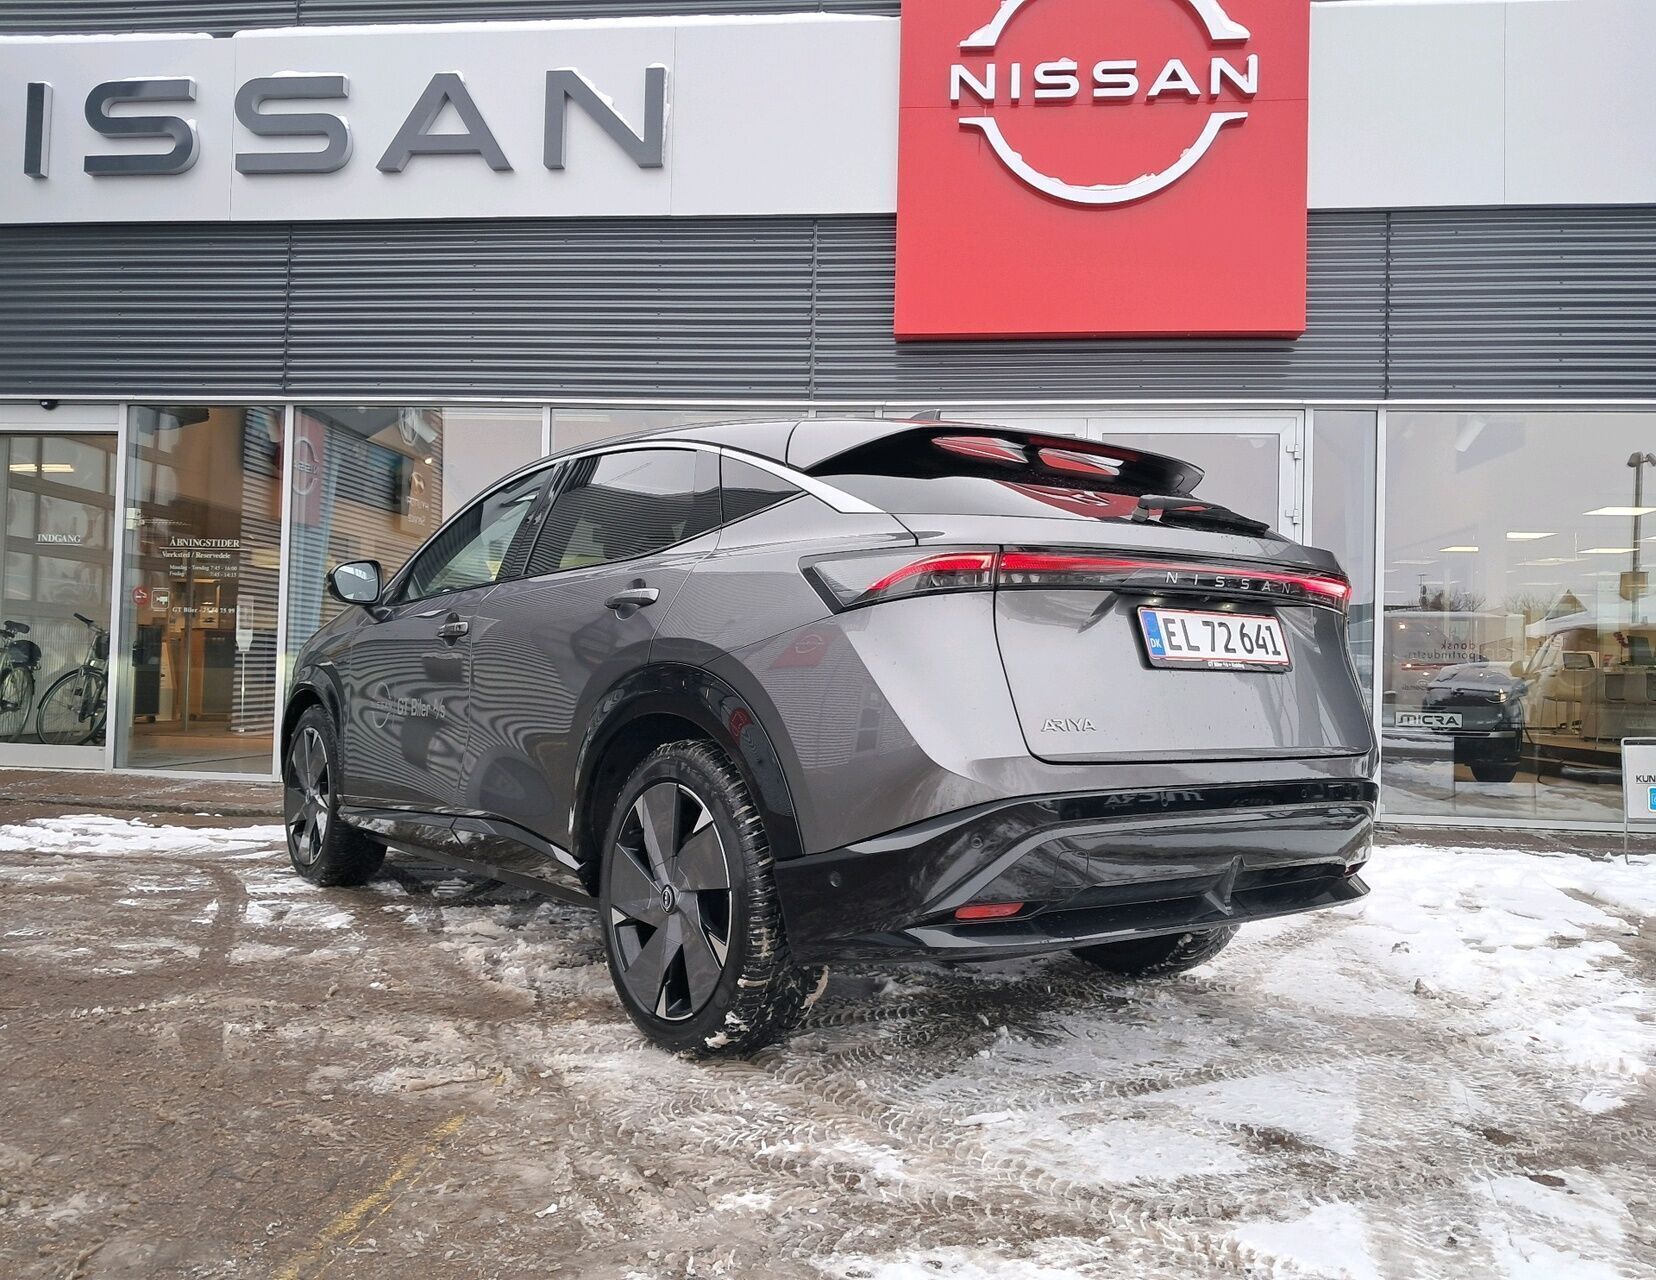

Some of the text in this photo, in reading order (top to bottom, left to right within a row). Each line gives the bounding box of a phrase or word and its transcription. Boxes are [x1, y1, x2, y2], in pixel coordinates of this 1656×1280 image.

[950, 54, 1258, 104] NISSAN
[36, 533, 81, 543] INDGANG
[169, 536, 240, 547] ÅBNINGSTIDER
[1165, 572, 1291, 594] NISSAN
[1162, 618, 1200, 651] EL
[1150, 638, 1162, 649] DK
[397, 697, 410, 715] GT
[411, 697, 431, 717] Biler
[1041, 718, 1097, 732] ARIYA
